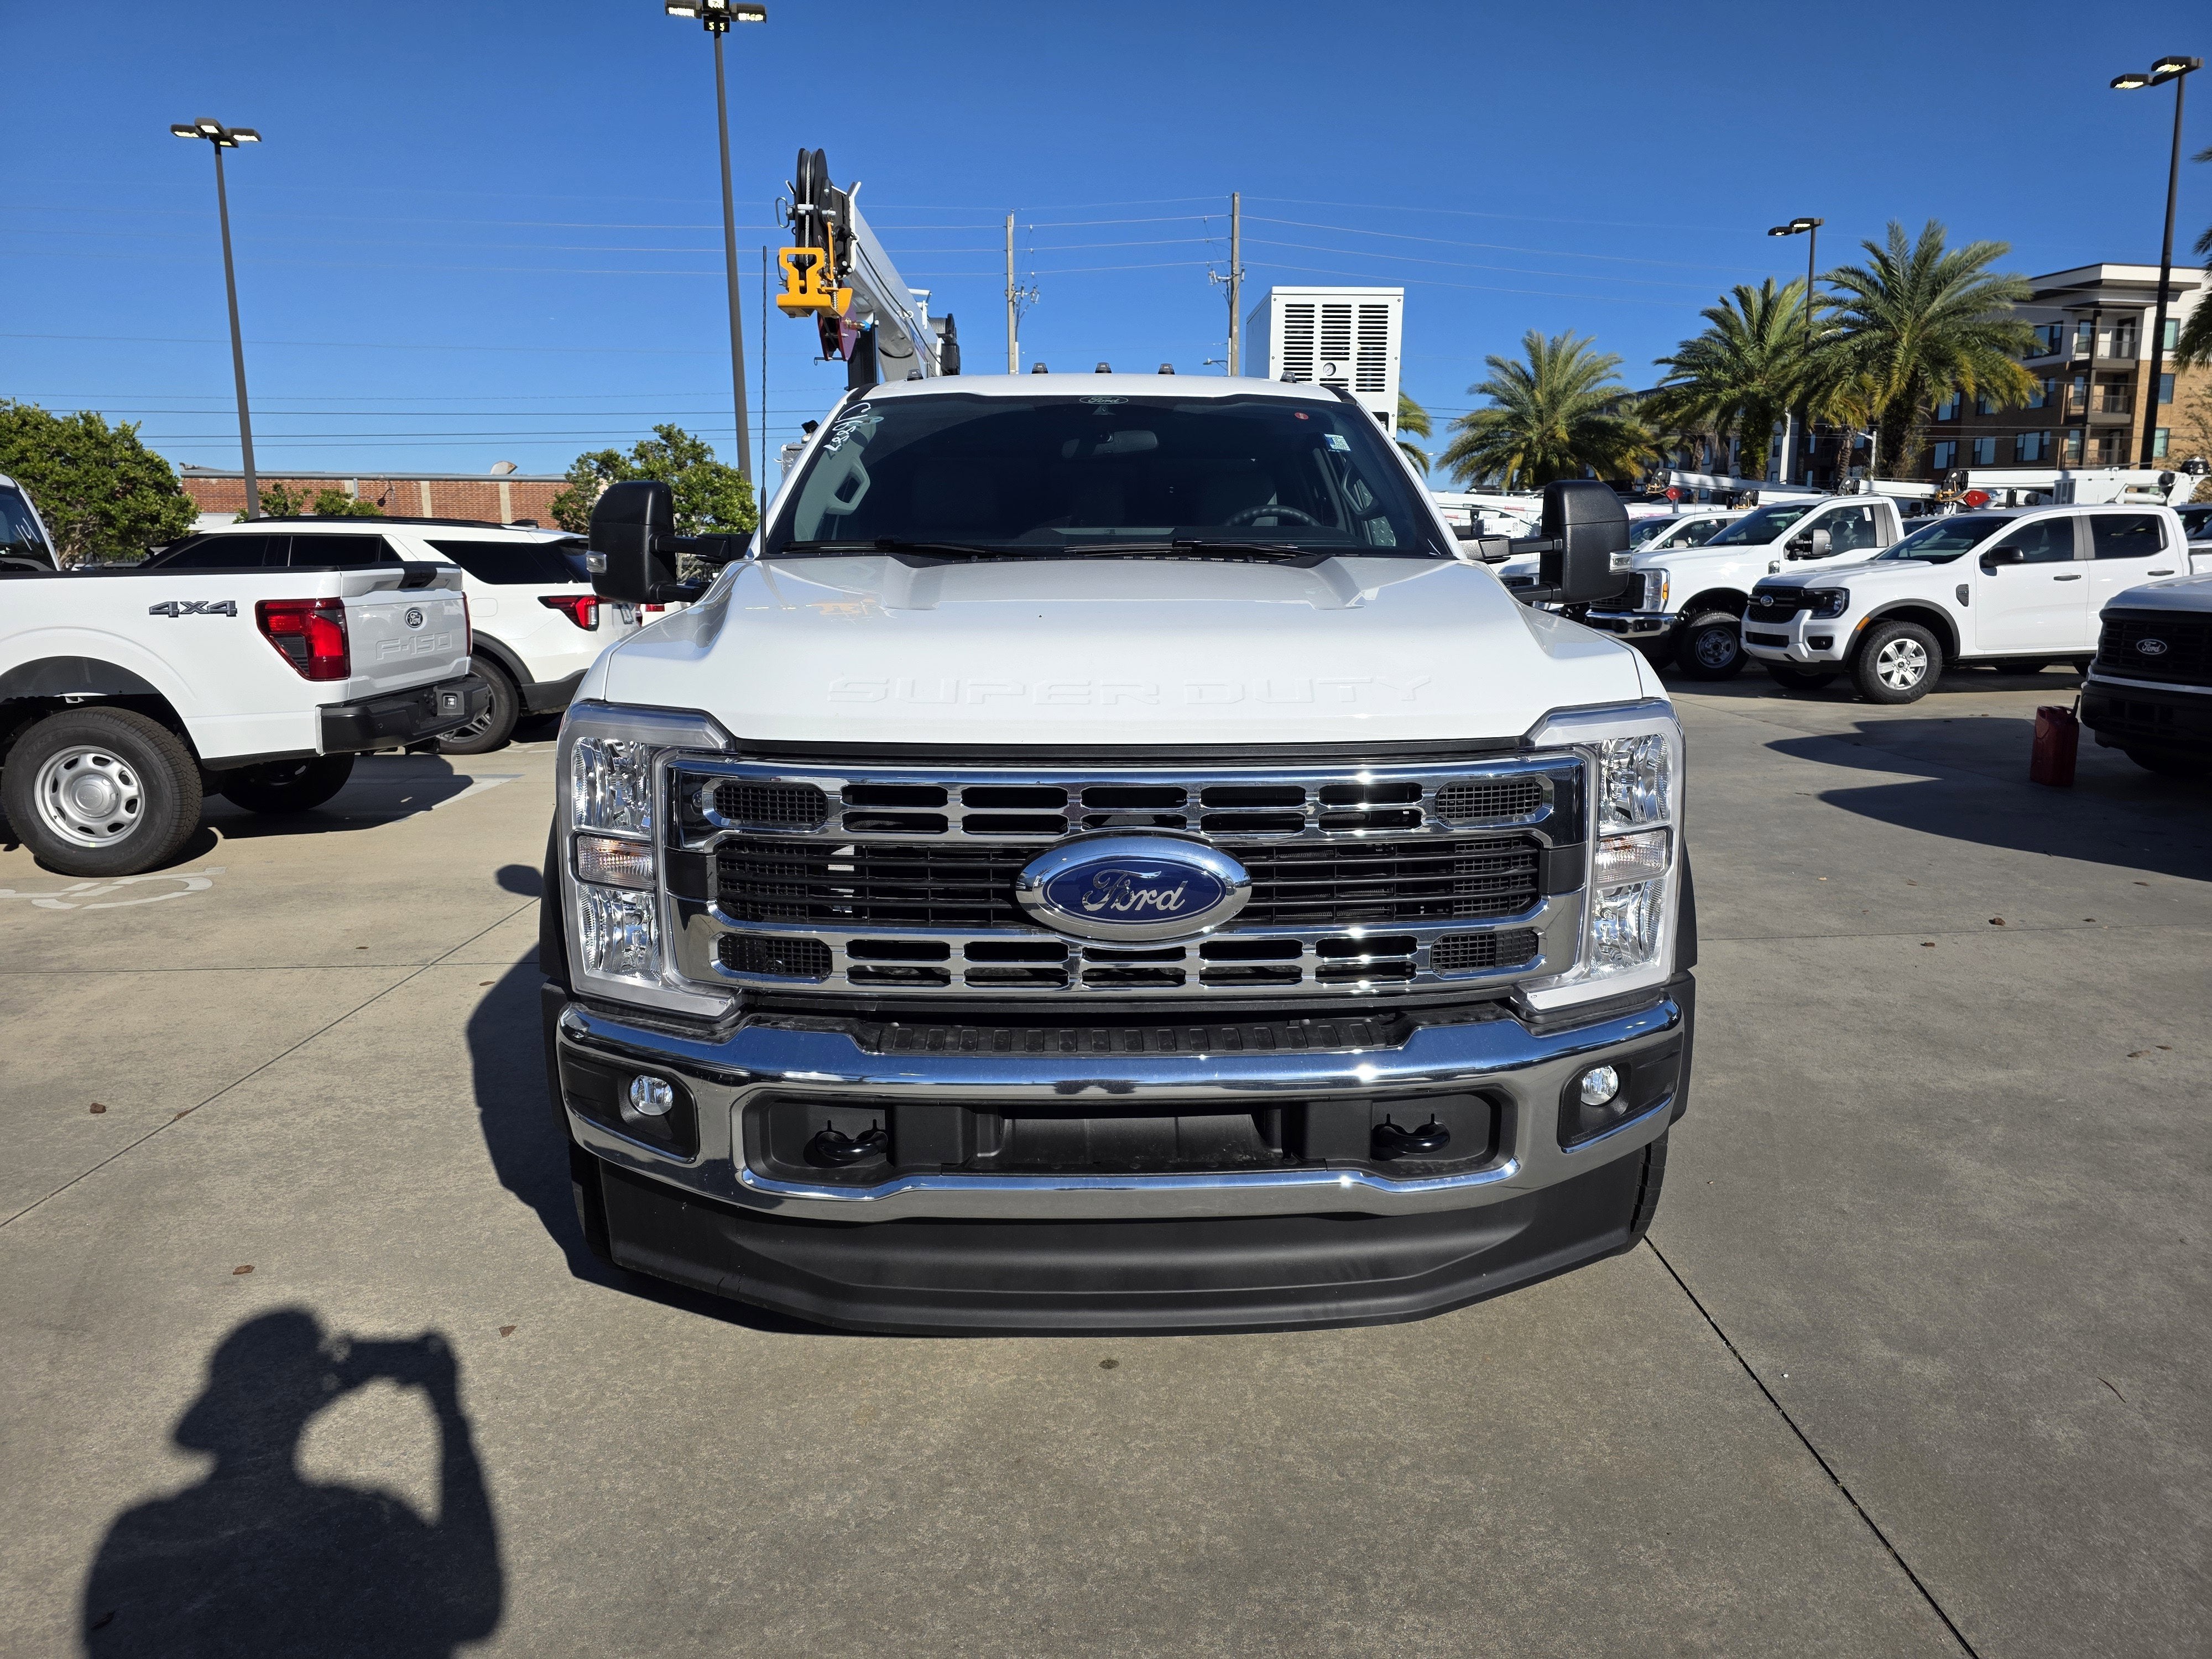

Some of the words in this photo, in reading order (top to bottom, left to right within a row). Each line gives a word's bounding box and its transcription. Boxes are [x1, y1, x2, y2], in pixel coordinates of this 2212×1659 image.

[375, 632, 452, 660] F-150
[2142, 641, 2161, 652] Ford
[828, 677, 1161, 706] SUPER
[1183, 675, 1432, 705] DUTY
[1082, 869, 1189, 912] Ford
